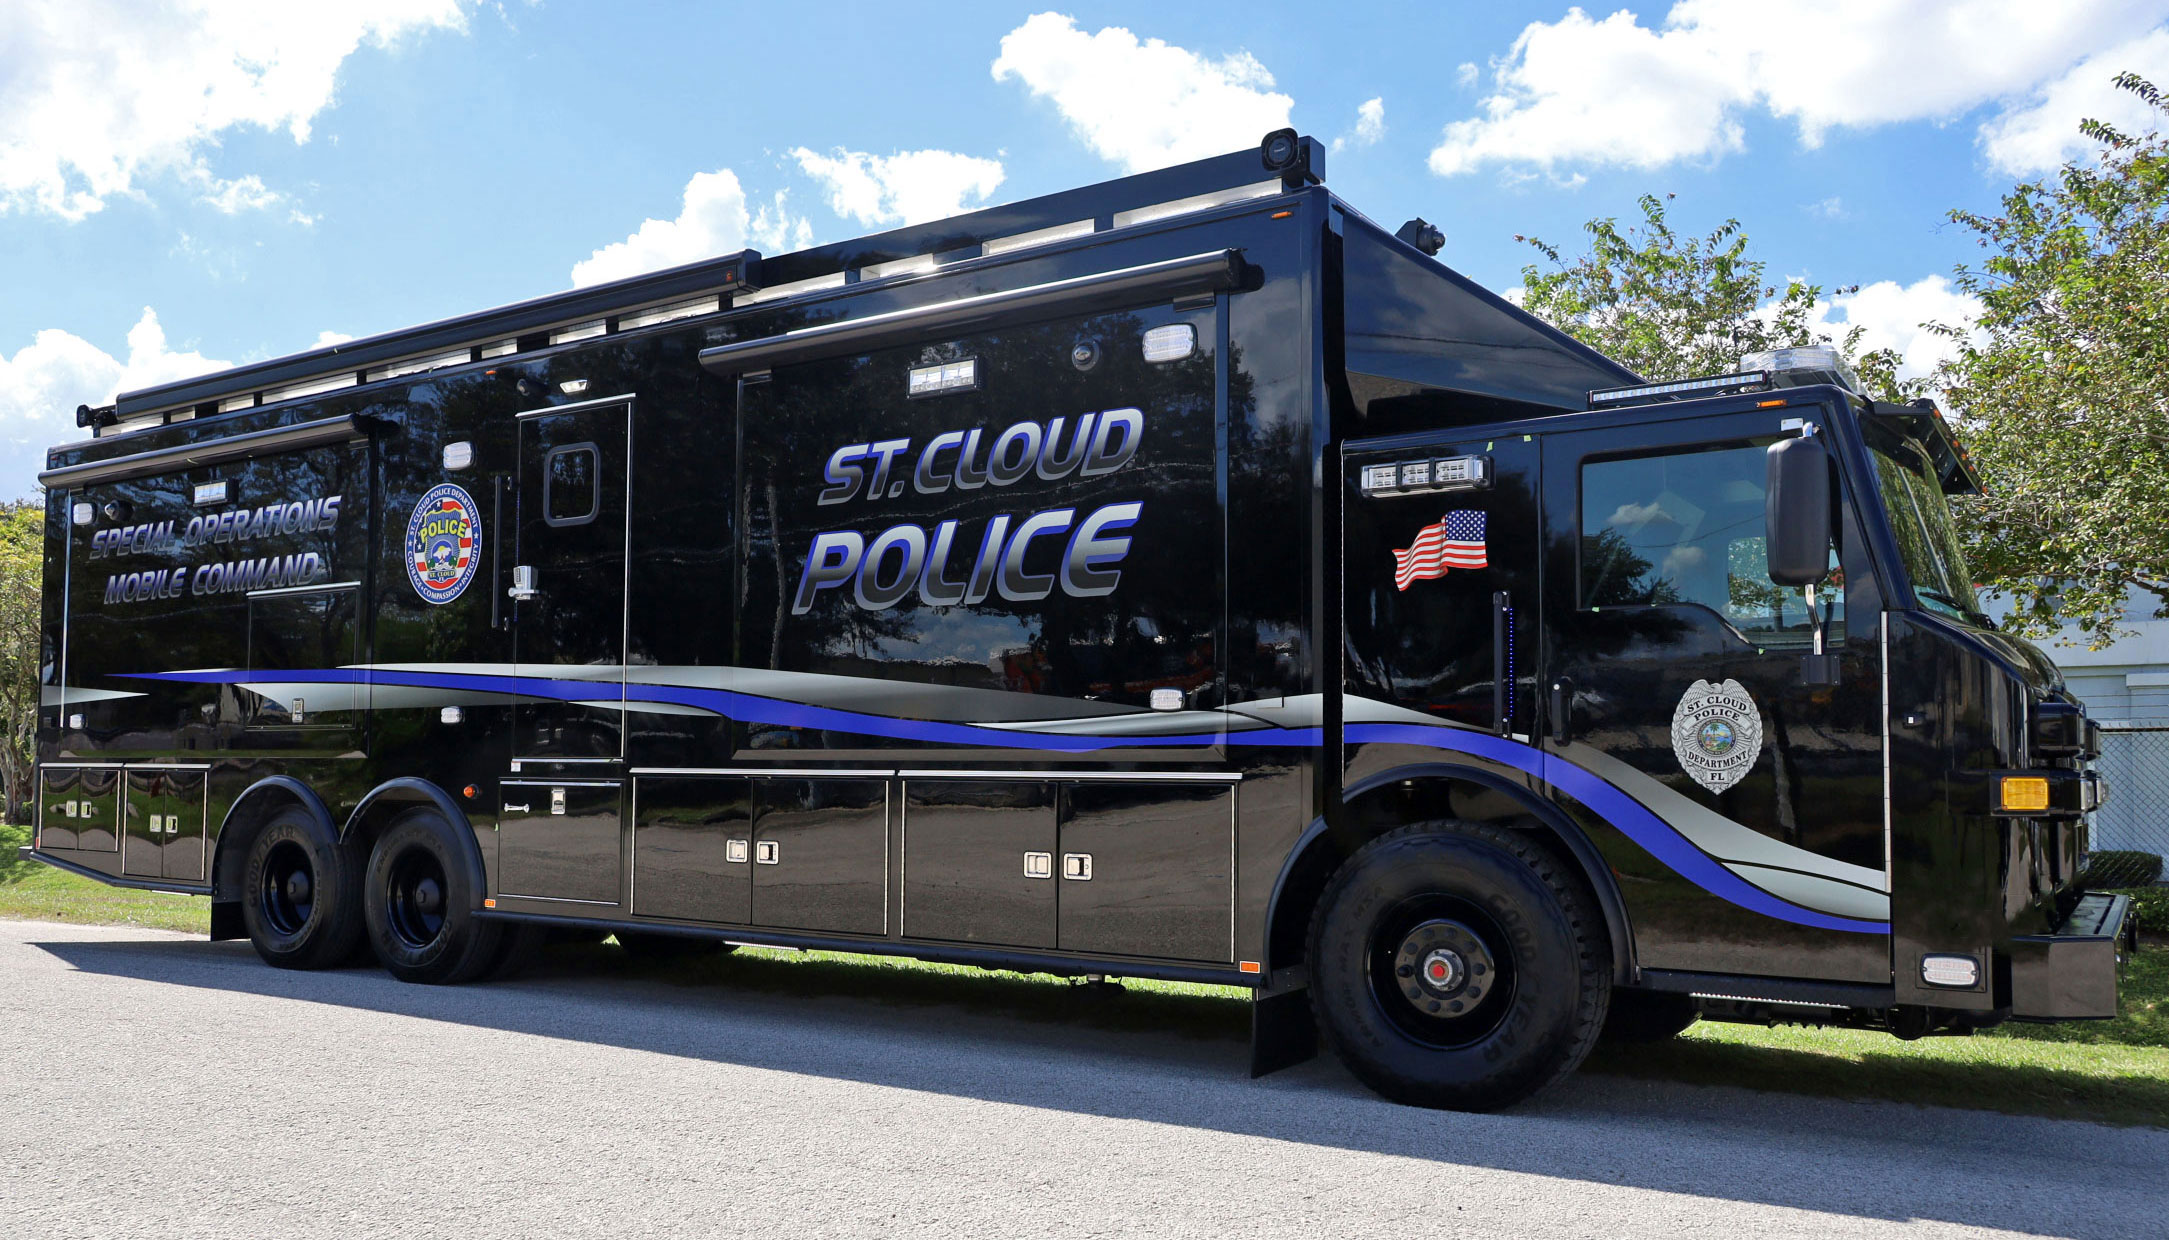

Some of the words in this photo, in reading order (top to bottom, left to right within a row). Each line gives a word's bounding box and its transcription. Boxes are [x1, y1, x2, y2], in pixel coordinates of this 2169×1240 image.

[913, 407, 1144, 495] CLOUD
[89, 520, 175, 560] SPECIAL
[184, 495, 342, 549] OPERATIONS
[414, 497, 430, 524] CLOUD
[430, 487, 451, 500] POLICE
[451, 489, 479, 528] DEPARTMENT
[420, 518, 467, 543] POLICE
[103, 567, 187, 605] MOBILE
[191, 552, 320, 596] COMMAND
[407, 551, 422, 589] COURAGE
[422, 585, 461, 600] COMPASSION
[461, 543, 480, 586] INTEGRITY
[791, 500, 1144, 616] POLICE
[1687, 701, 1704, 713] ST.
[1707, 696, 1747, 712] CLOUD
[1694, 708, 1741, 722] POLICE
[1688, 750, 1749, 769] DEPARTMENT
[1710, 772, 1725, 781] FL
